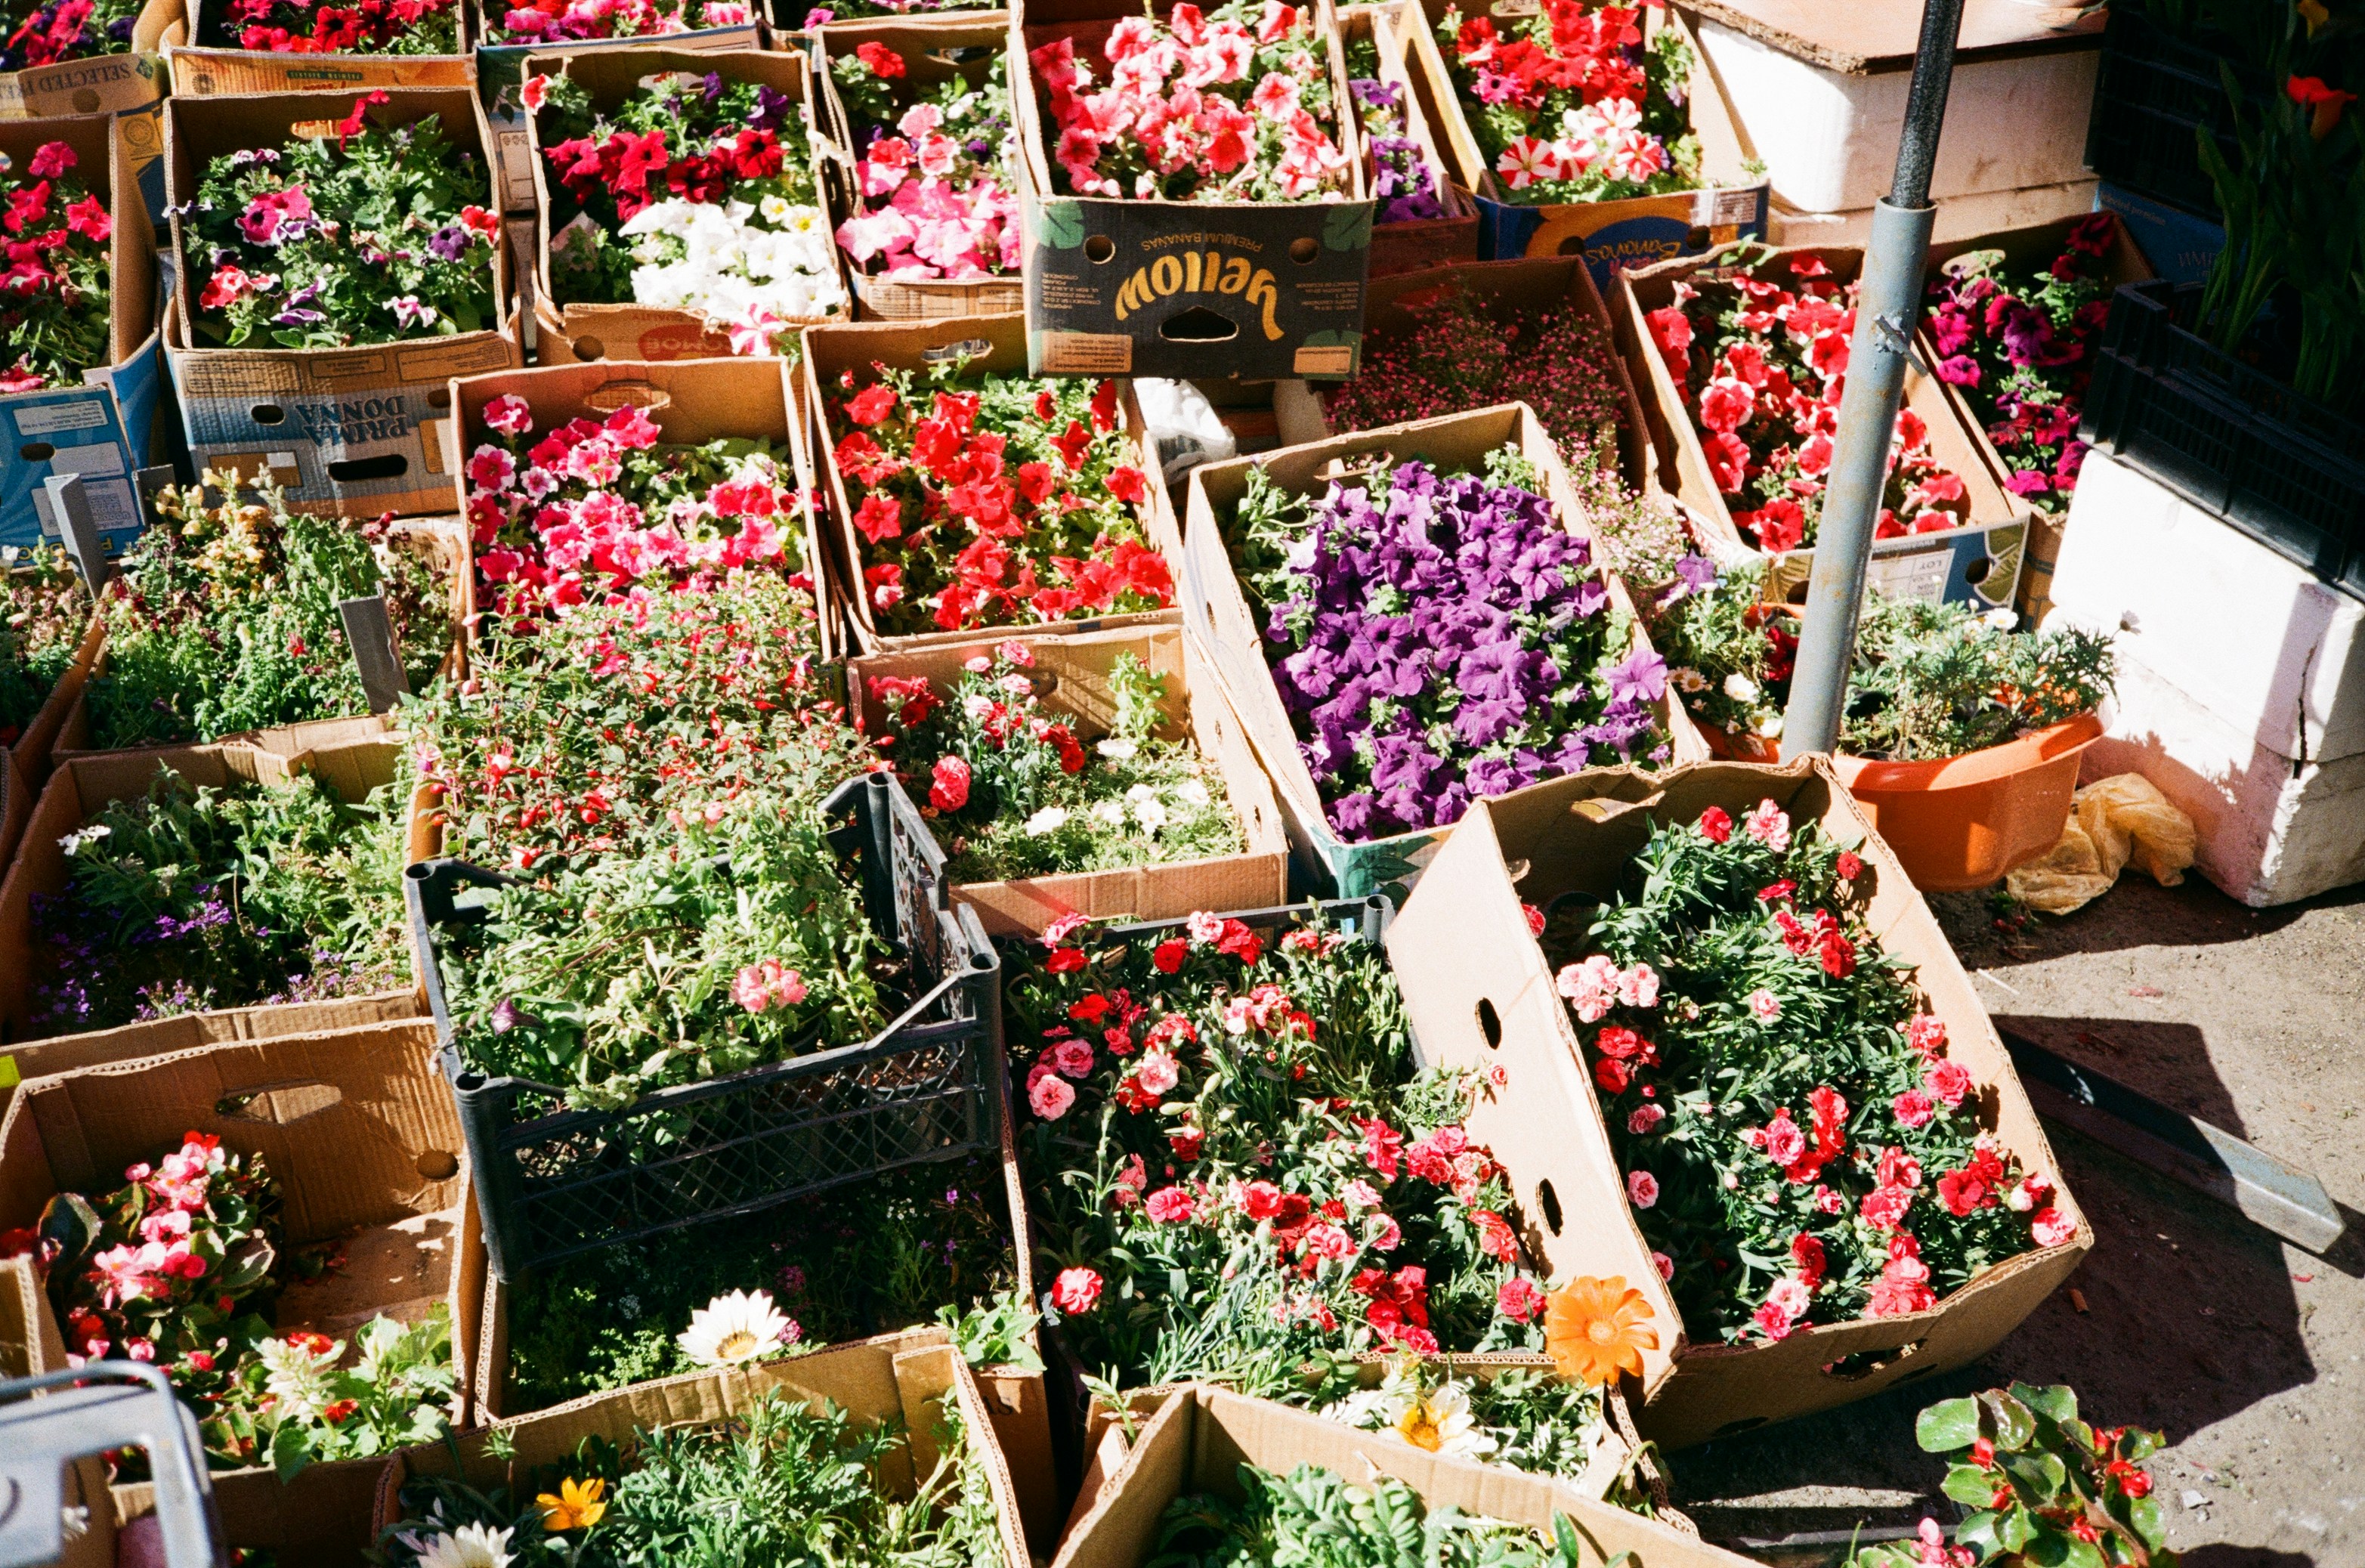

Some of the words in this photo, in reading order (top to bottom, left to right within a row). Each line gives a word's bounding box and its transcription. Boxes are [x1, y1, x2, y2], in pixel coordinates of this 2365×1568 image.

[39, 63, 131, 93] SELECTED
[1140, 232, 1202, 252] BANANAS
[1204, 231, 1263, 252] PREMIUM
[1585, 240, 1682, 265] Bananas
[1114, 250, 1285, 341] yellow
[295, 394, 406, 427] DONNA
[302, 416, 411, 448] PRIMA
[1919, 559, 1943, 571] LOT
